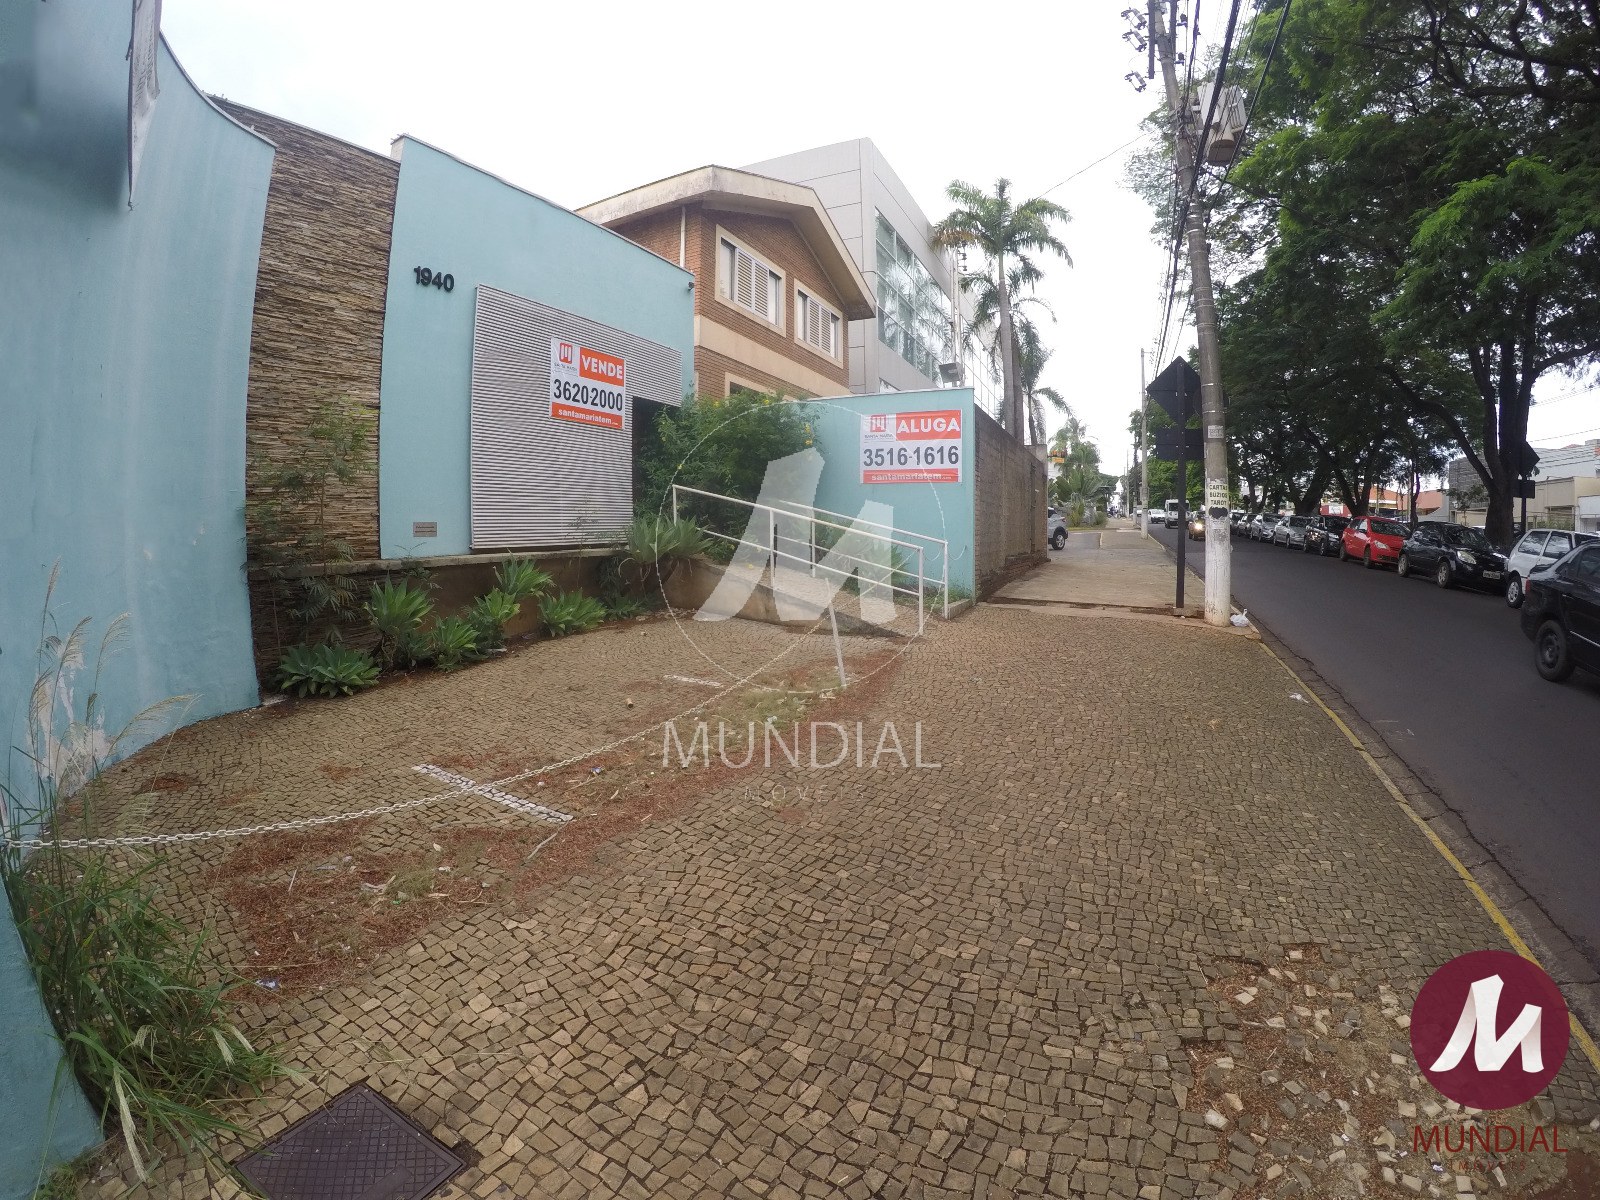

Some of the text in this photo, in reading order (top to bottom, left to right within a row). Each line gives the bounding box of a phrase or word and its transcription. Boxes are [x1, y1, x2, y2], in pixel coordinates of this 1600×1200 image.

[413, 265, 455, 292] 1940
[582, 355, 623, 379] VENDE
[553, 378, 623, 411] 3620-2000
[897, 417, 961, 434] ALUGA
[863, 445, 960, 467] 3516-1616
